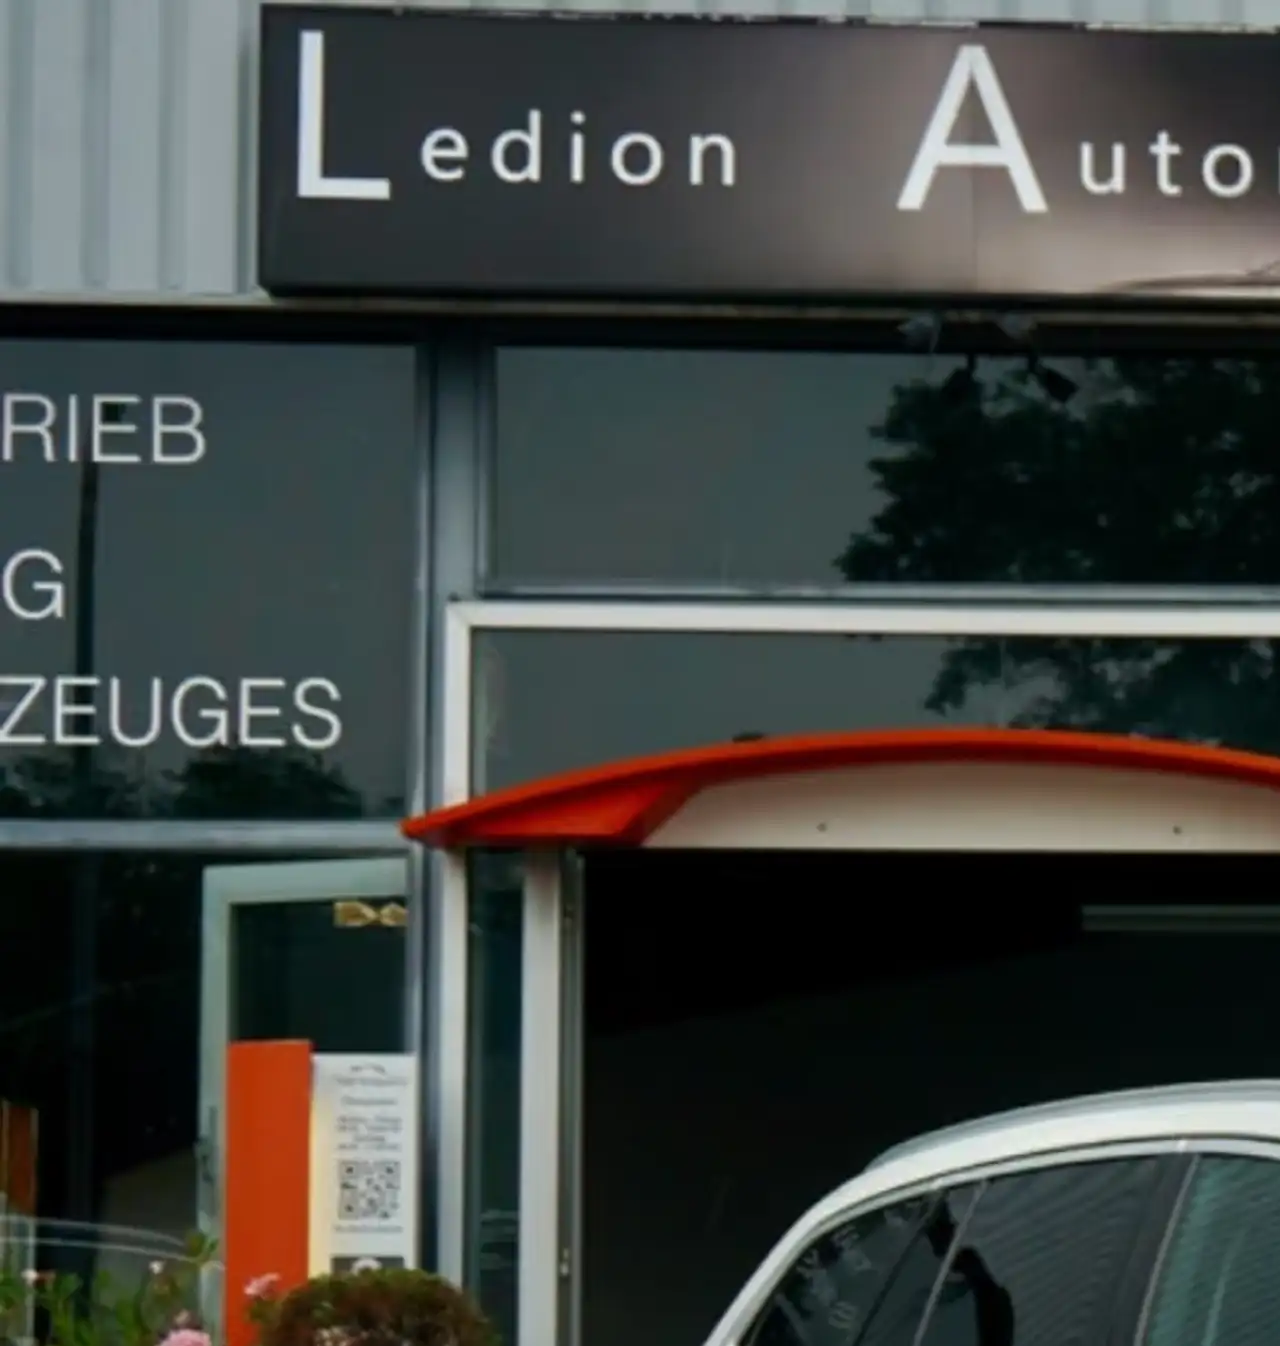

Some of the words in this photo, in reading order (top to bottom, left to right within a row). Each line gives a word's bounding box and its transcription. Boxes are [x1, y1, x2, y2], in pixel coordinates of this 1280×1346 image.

[297, 30, 736, 200] Ledion
[1, 392, 207, 465] RIEB
[1, 547, 65, 621] G
[0, 674, 343, 750] ZEUGES
